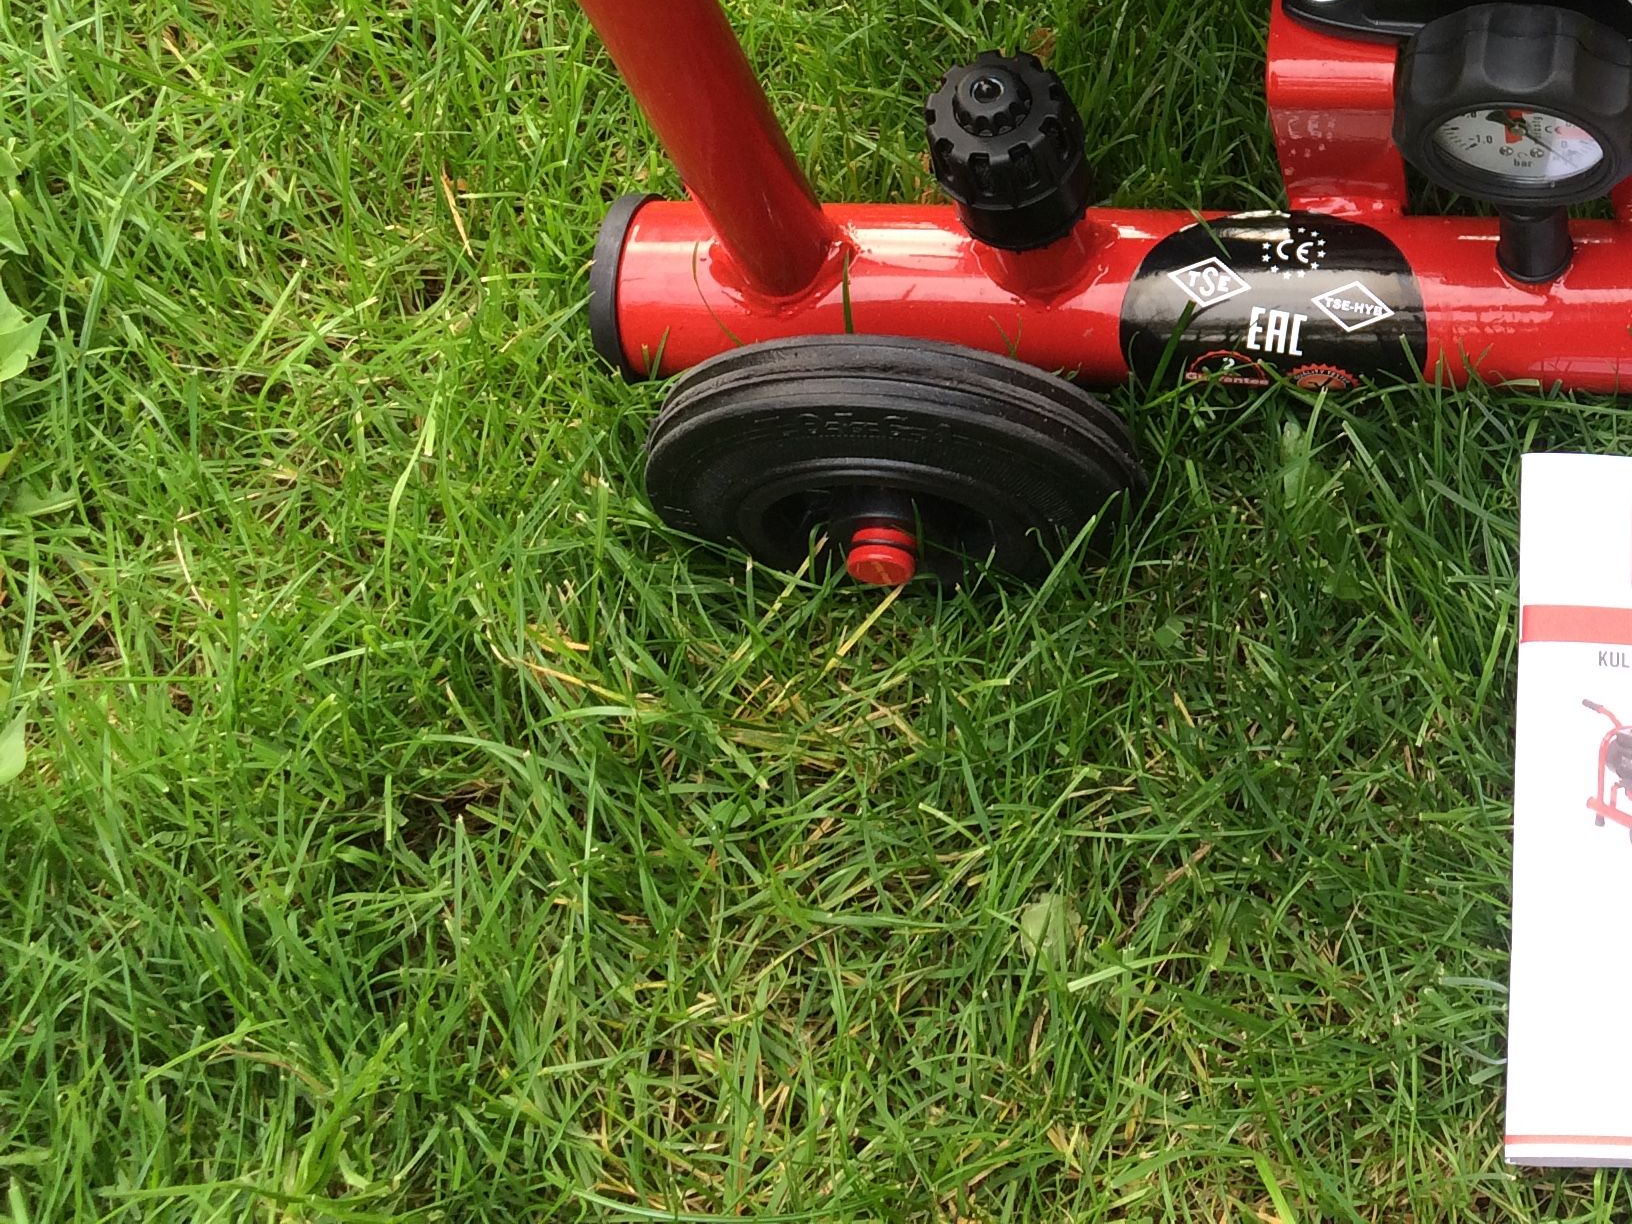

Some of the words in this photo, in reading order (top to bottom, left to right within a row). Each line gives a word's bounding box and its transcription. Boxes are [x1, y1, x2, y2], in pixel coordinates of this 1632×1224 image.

[1513, 158, 1534, 168] bar
[1186, 267, 1232, 297] TSE
[1246, 306, 1308, 357] EAC
